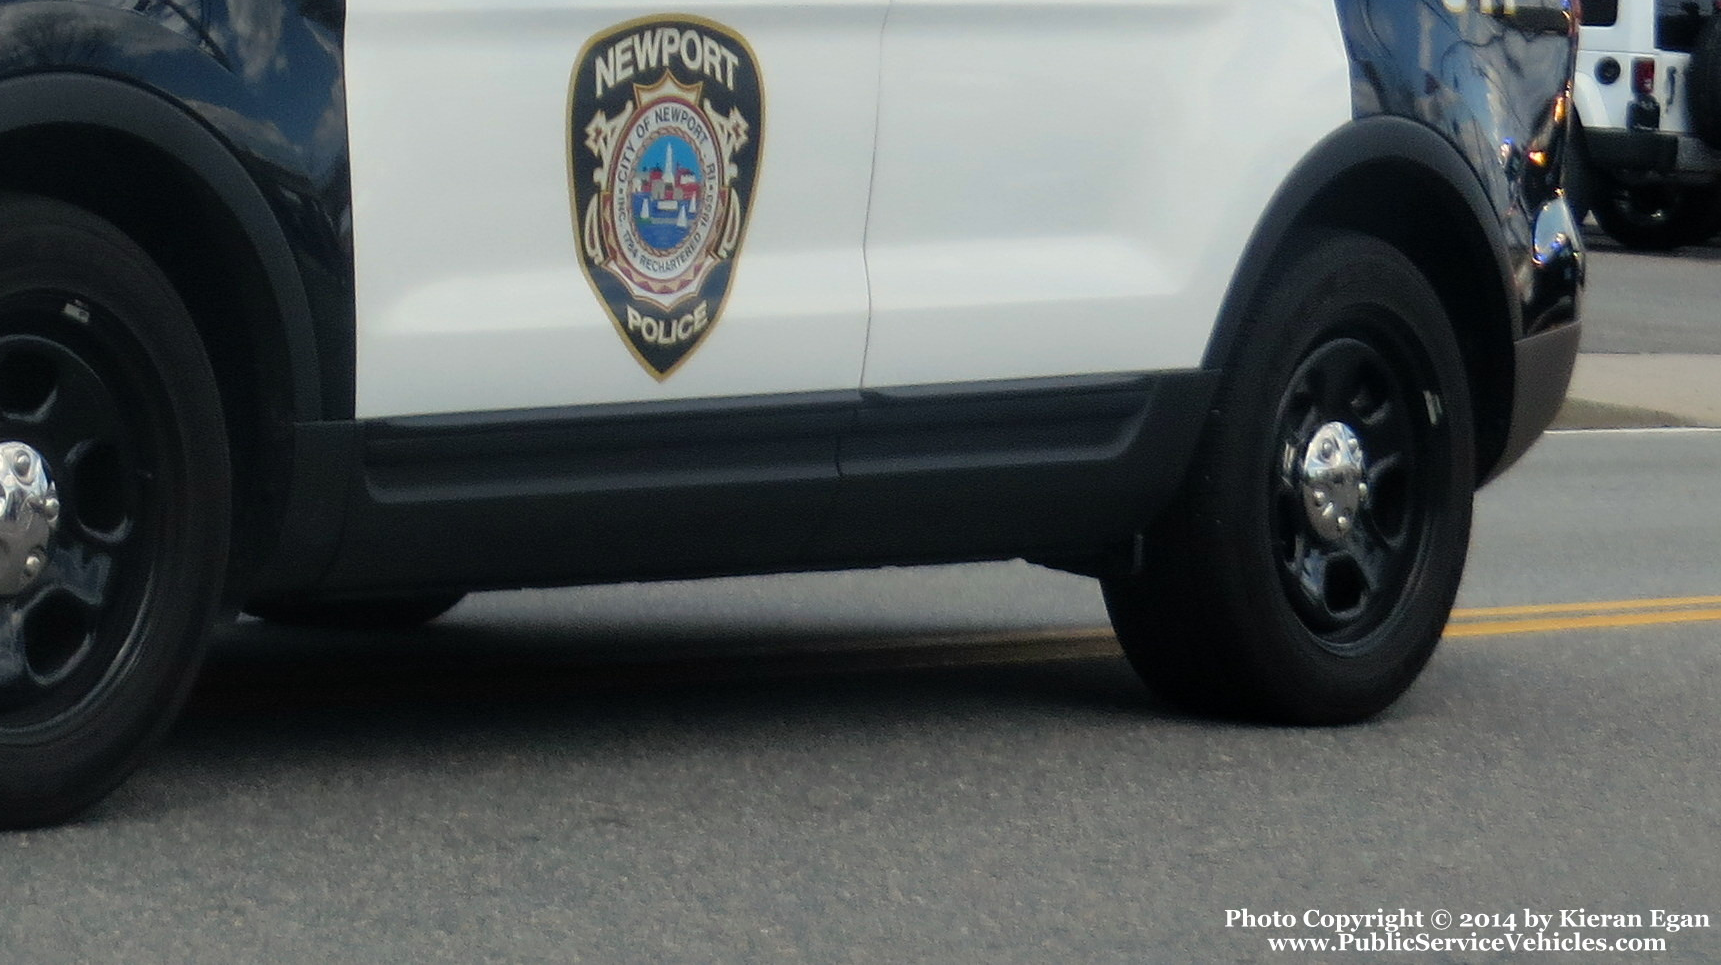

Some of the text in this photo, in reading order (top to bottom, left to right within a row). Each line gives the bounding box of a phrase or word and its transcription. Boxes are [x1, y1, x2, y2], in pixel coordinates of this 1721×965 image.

[594, 27, 740, 99] NEWPORT
[617, 139, 636, 183] CITY
[636, 116, 650, 139] OF
[655, 106, 708, 144] NEWPORT
[639, 232, 702, 272] RECHARTERED
[626, 299, 710, 344] POLICE
